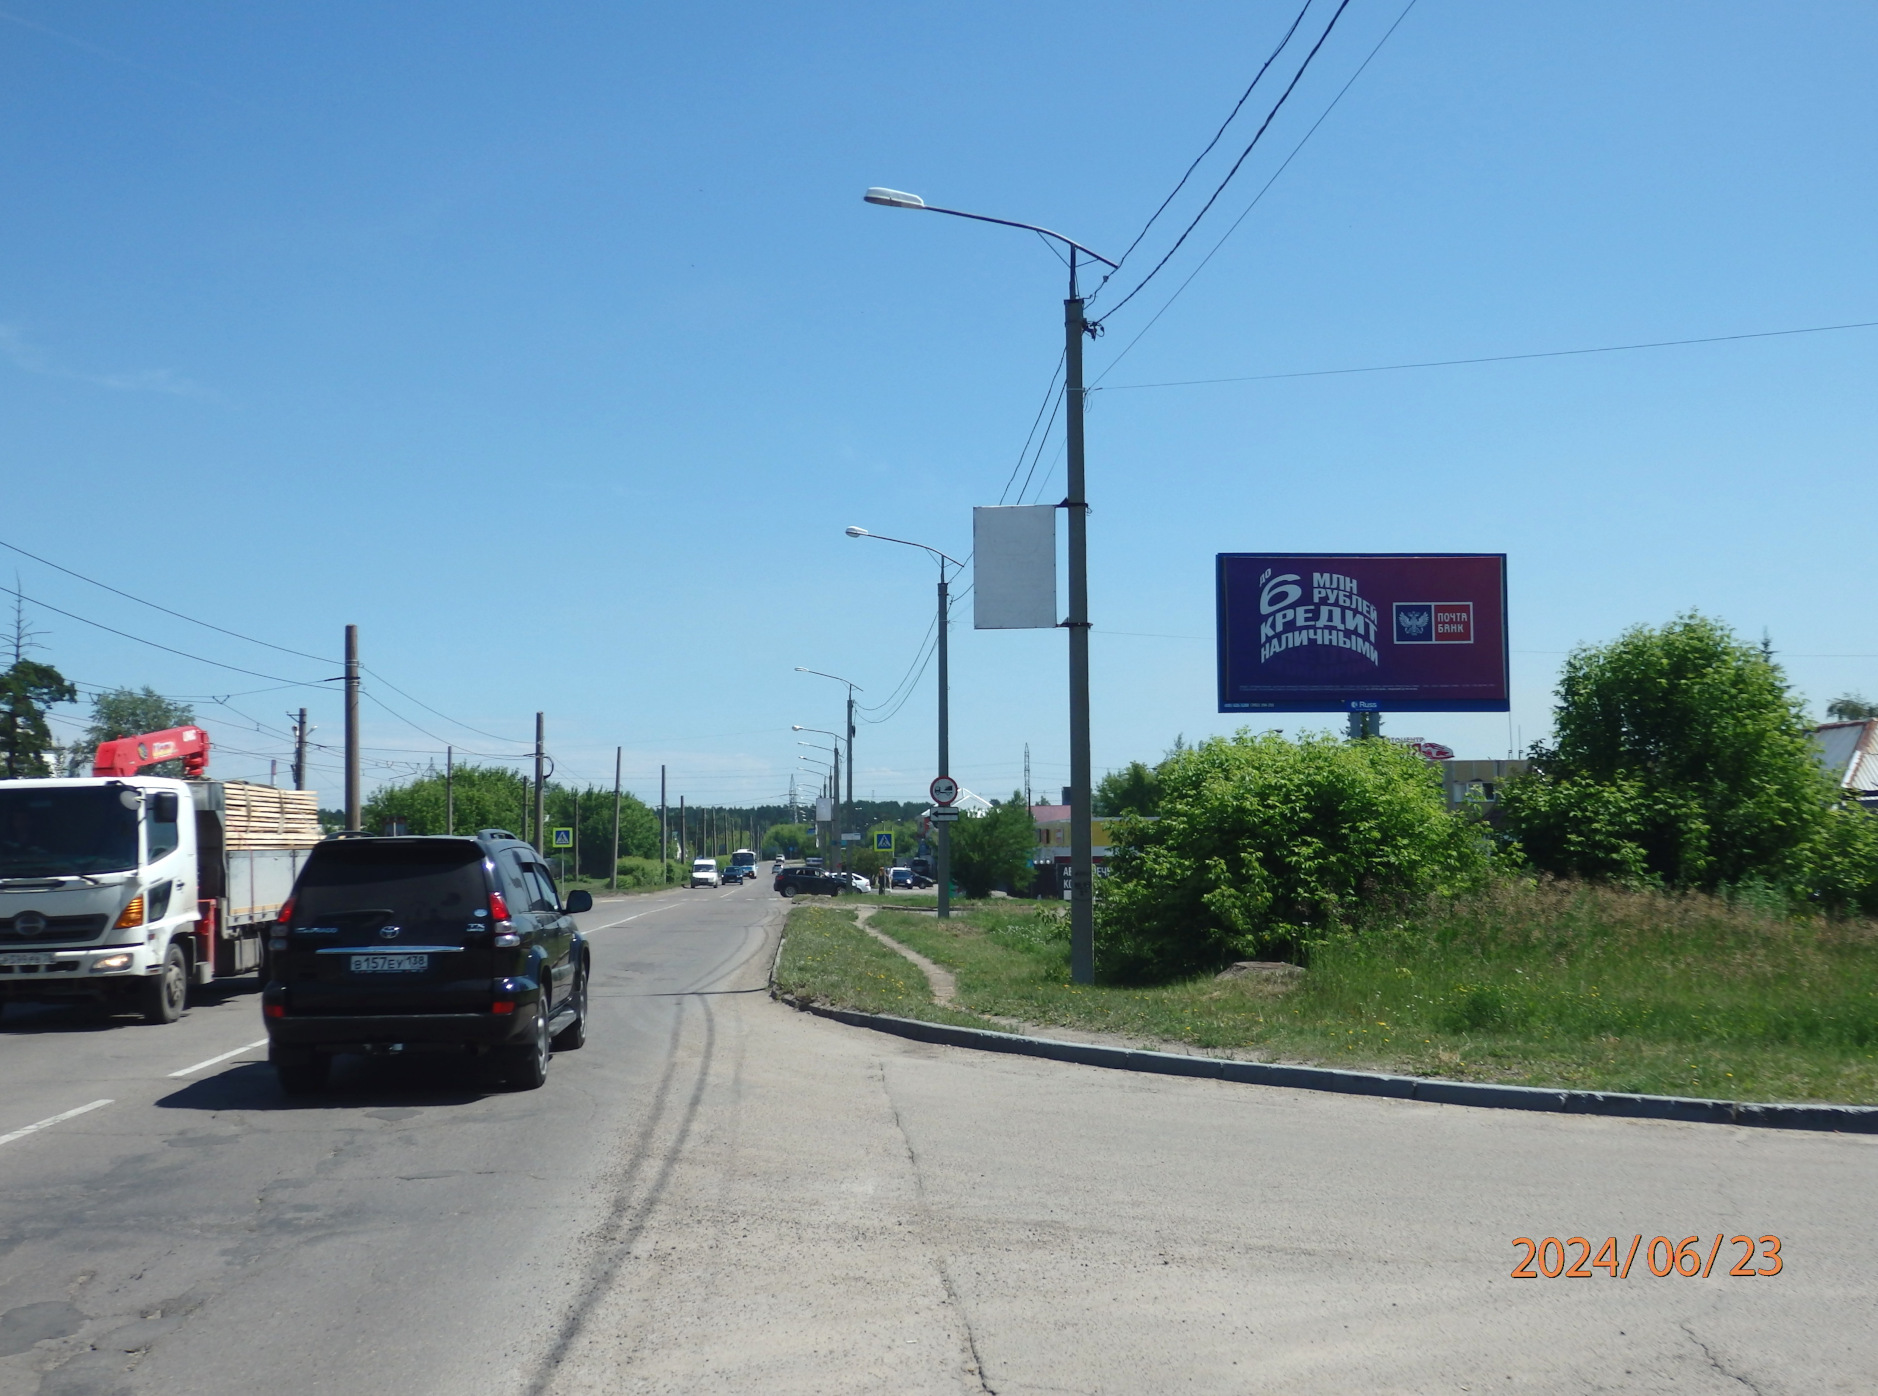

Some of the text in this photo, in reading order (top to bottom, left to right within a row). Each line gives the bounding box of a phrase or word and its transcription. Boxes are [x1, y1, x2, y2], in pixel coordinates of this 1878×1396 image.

[1260, 573, 1357, 615] 6 МЛН
[1313, 588, 1377, 625] РУБЛЕЙ
[1261, 605, 1377, 644] КРЕДИТ
[1437, 613, 1467, 622] ПОЧТА
[1438, 624, 1464, 633] БАНК
[1261, 629, 1378, 666] НАЛИЧНЫМИ
